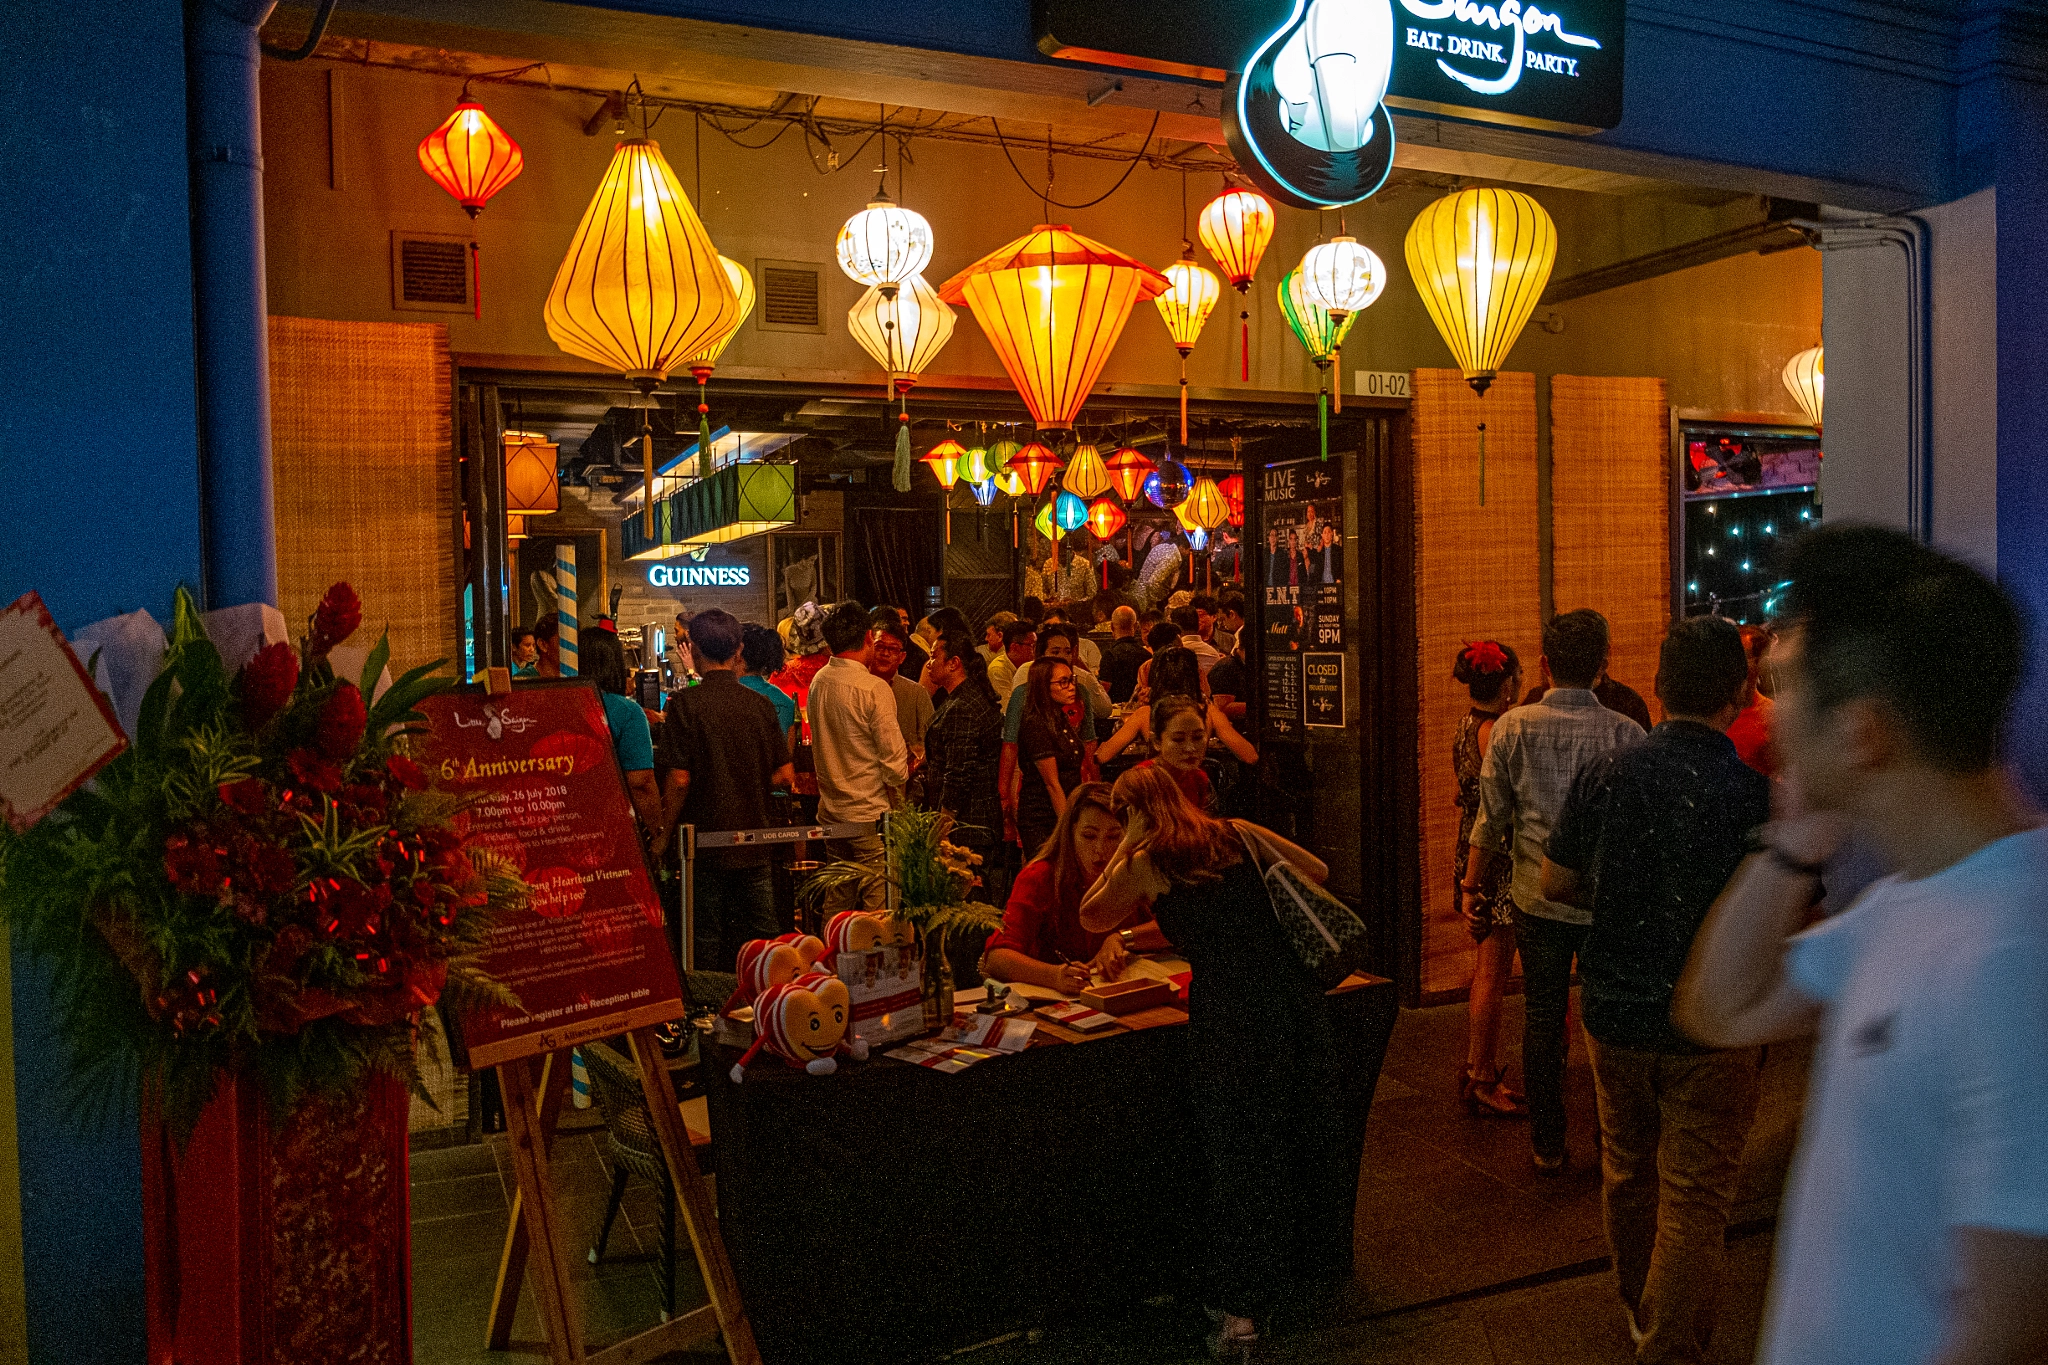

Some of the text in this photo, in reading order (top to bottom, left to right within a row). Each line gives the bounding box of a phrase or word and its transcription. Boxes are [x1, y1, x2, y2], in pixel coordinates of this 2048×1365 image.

[1369, 374, 1405, 395] 01-02
[1264, 468, 1296, 489] LIVE
[1264, 487, 1296, 502] MUSIC
[648, 564, 751, 587] GUINNESS
[1318, 615, 1340, 623] SUNDAY
[1318, 629, 1341, 644] 9PM
[1307, 664, 1339, 675] CLOSED
[464, 755, 575, 780] Anniversary
[513, 790, 525, 801] 26
[527, 788, 542, 801] July
[544, 785, 568, 797] 2018
[477, 800, 566, 818] 7.00pm to 10.00pm
[547, 824, 571, 834] drinks
[552, 872, 595, 888] Heartbeat
[549, 891, 568, 906] help
[500, 1016, 530, 1029] Please
[565, 1004, 574, 1014] at
[575, 1001, 588, 1012] the
[589, 993, 630, 1009] Reception
[631, 988, 650, 999] table
